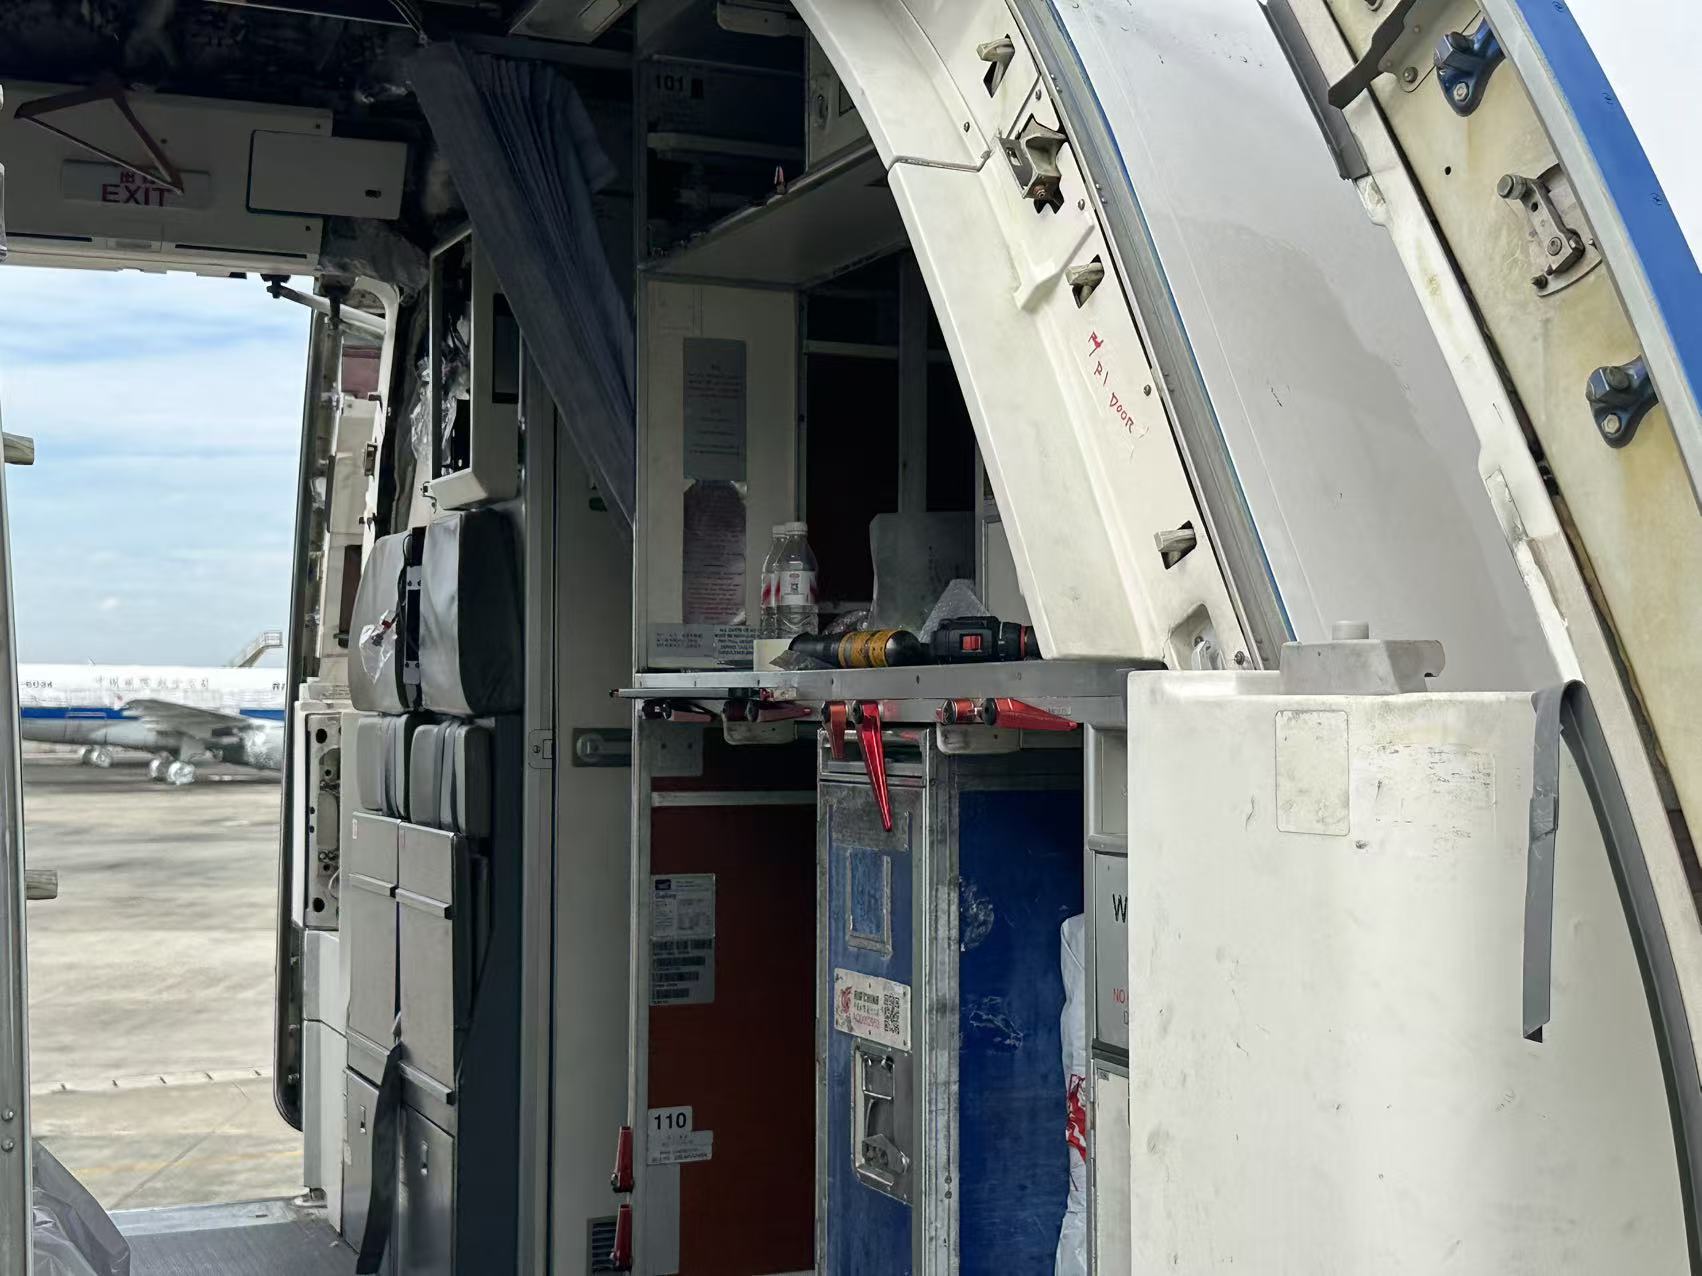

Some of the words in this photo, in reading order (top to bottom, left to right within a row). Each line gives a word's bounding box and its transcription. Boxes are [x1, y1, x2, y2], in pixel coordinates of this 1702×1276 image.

[656, 74, 684, 93] 101
[102, 184, 173, 207] EXIT
[1109, 392, 1135, 434] DOOR
[654, 1112, 687, 1130] 110
